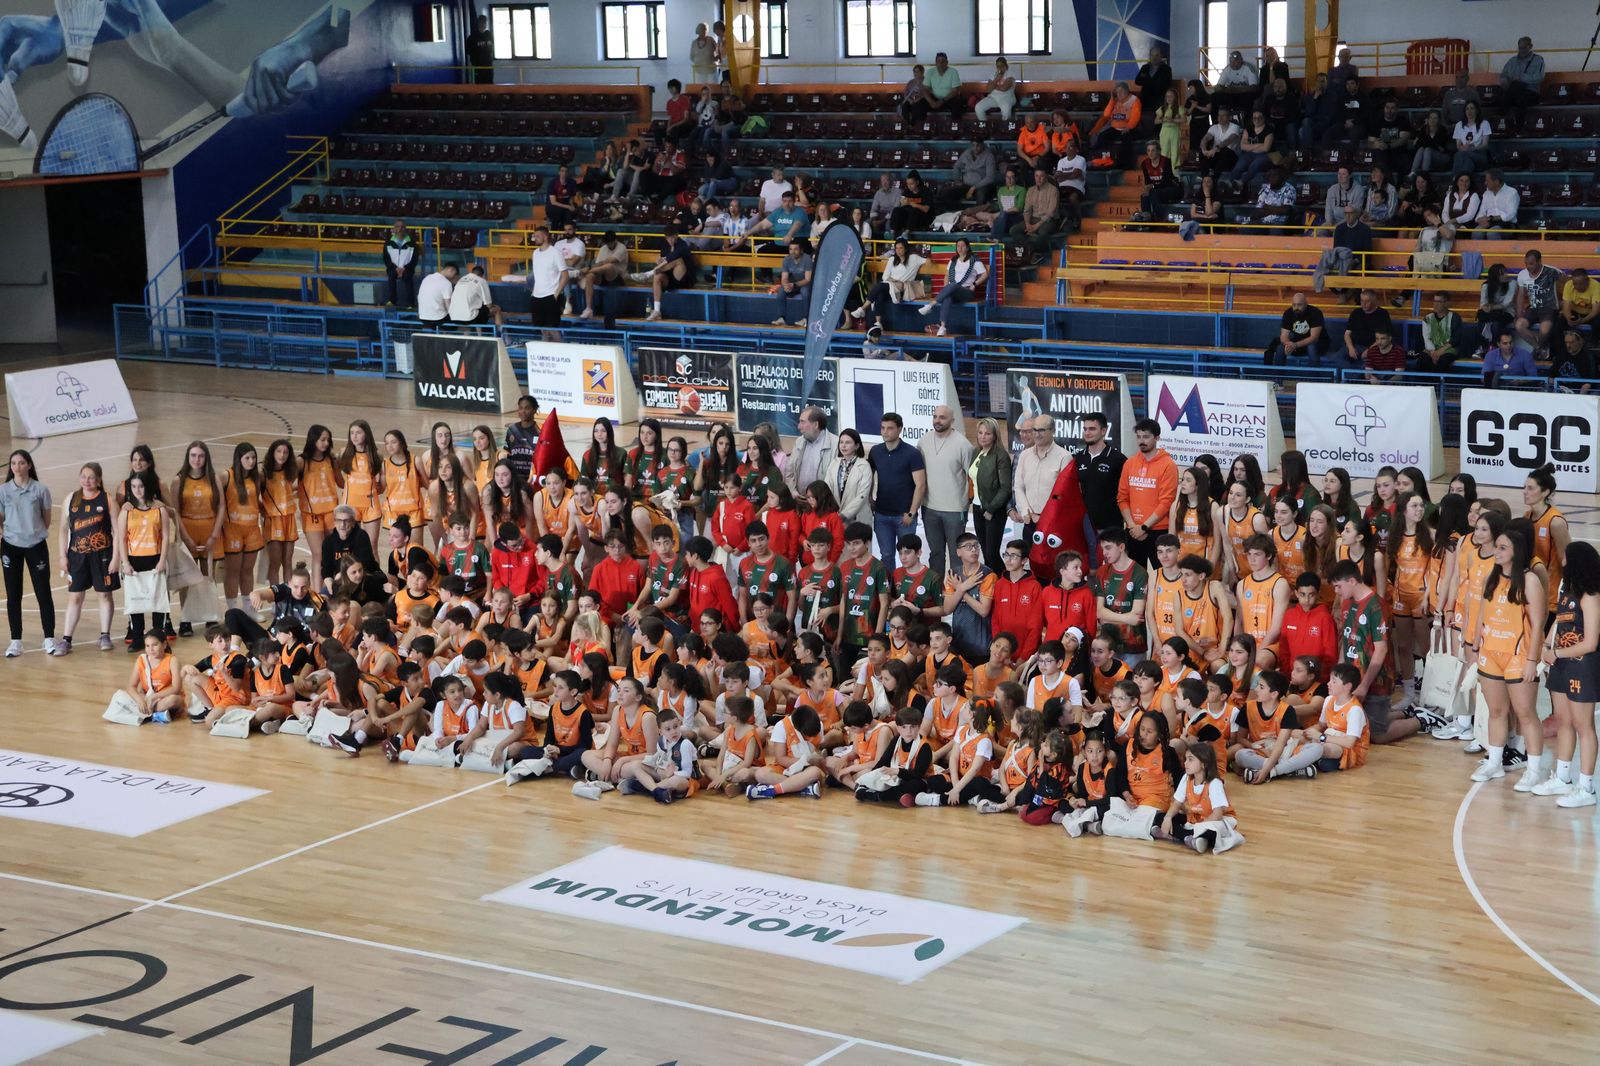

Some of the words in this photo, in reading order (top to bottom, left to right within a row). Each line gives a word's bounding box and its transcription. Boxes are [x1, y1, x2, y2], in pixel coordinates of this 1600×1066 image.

[821, 272, 843, 316] recoletas
[756, 365, 789, 379] PALACIO
[903, 371, 918, 383] LUIS
[919, 372, 940, 384] FELIPE
[756, 378, 789, 390] ZAMORA
[1035, 374, 1066, 388] TÉCNICA
[1067, 379, 1074, 388] Y
[1074, 378, 1115, 391] ORTOPEDIA
[418, 382, 496, 402] VALCARCE
[645, 390, 678, 403] COMPITE
[700, 391, 728, 408] SUEÑA
[918, 387, 940, 401] GÓMEZ
[741, 398, 787, 413] Restaurante
[1049, 393, 1103, 414] ANTONIO
[45, 409, 92, 424] recoletas
[92, 402, 118, 419] salud
[1467, 409, 1591, 469] G3C
[1304, 446, 1375, 464] recoletas
[1379, 449, 1420, 466] salud
[1466, 456, 1504, 467] GIMNASIO
[1163, 613, 1173, 624] 33
[1569, 679, 1581, 694] 24
[64, 766, 110, 780] LA
[100, 773, 156, 787] DE
[734, 885, 809, 902] GROUP
[528, 877, 847, 943] MOLENDUM
[635, 879, 871, 927] INGREDIENTS
[815, 898, 888, 916] DACSA
